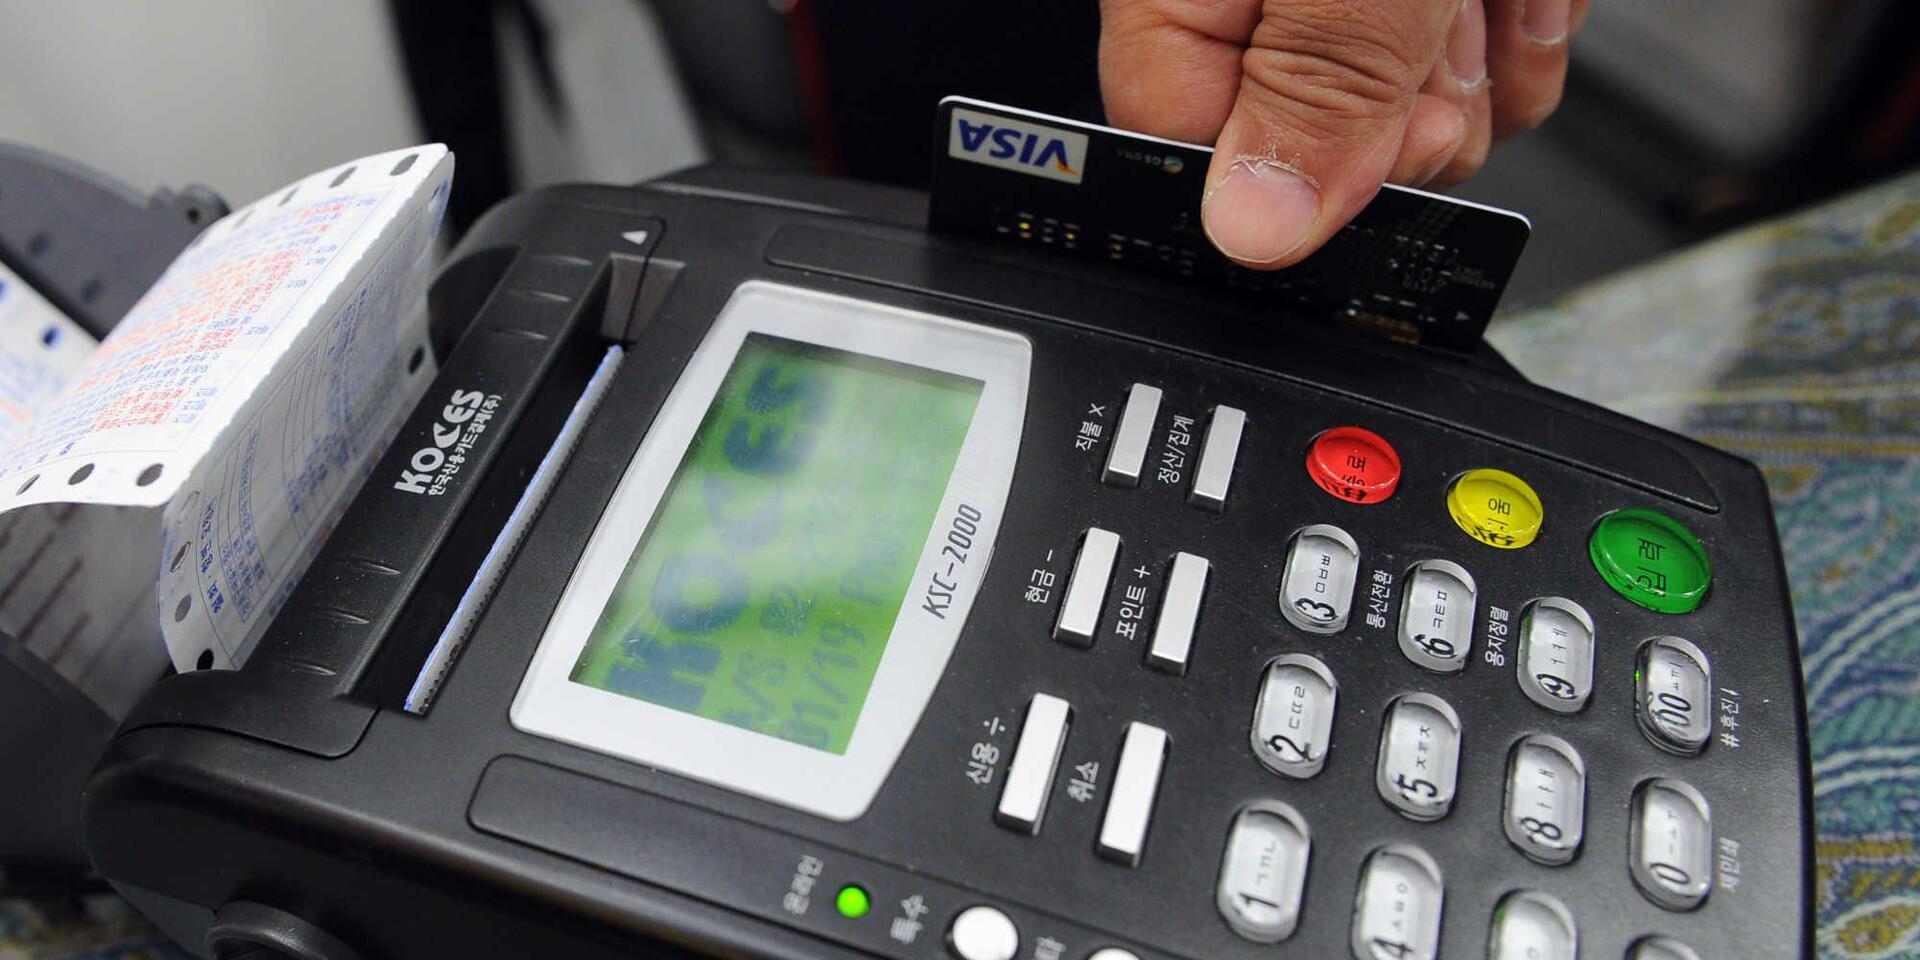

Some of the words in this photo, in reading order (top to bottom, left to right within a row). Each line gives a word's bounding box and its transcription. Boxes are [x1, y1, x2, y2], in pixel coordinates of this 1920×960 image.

[958, 118, 1074, 174] VISA
[394, 389, 484, 494] KOCES
[1074, 423, 1102, 452] 직불
[1156, 414, 1195, 485] 정산/집계
[604, 364, 836, 708] KOCES
[922, 504, 982, 619] KSC-2000
[1636, 538, 1667, 597] 입력
[1024, 569, 1055, 602] 현금
[1366, 569, 1392, 629] 통신전환
[1113, 586, 1147, 641] 포인트
[1295, 598, 1338, 622] 3
[1414, 634, 1458, 658] 6
[1485, 606, 1509, 667] 용지정렬
[1536, 673, 1577, 699] 9
[1655, 692, 1692, 726] 00
[1721, 693, 1740, 731] 후진
[966, 742, 999, 785] 신용
[1265, 734, 1314, 761] 2
[1067, 761, 1100, 803] 취소
[1394, 773, 1438, 800] 5
[1520, 816, 1562, 843] 8
[1649, 862, 1690, 885] 0
[1239, 892, 1281, 909] 1
[1373, 936, 1414, 960] 4
